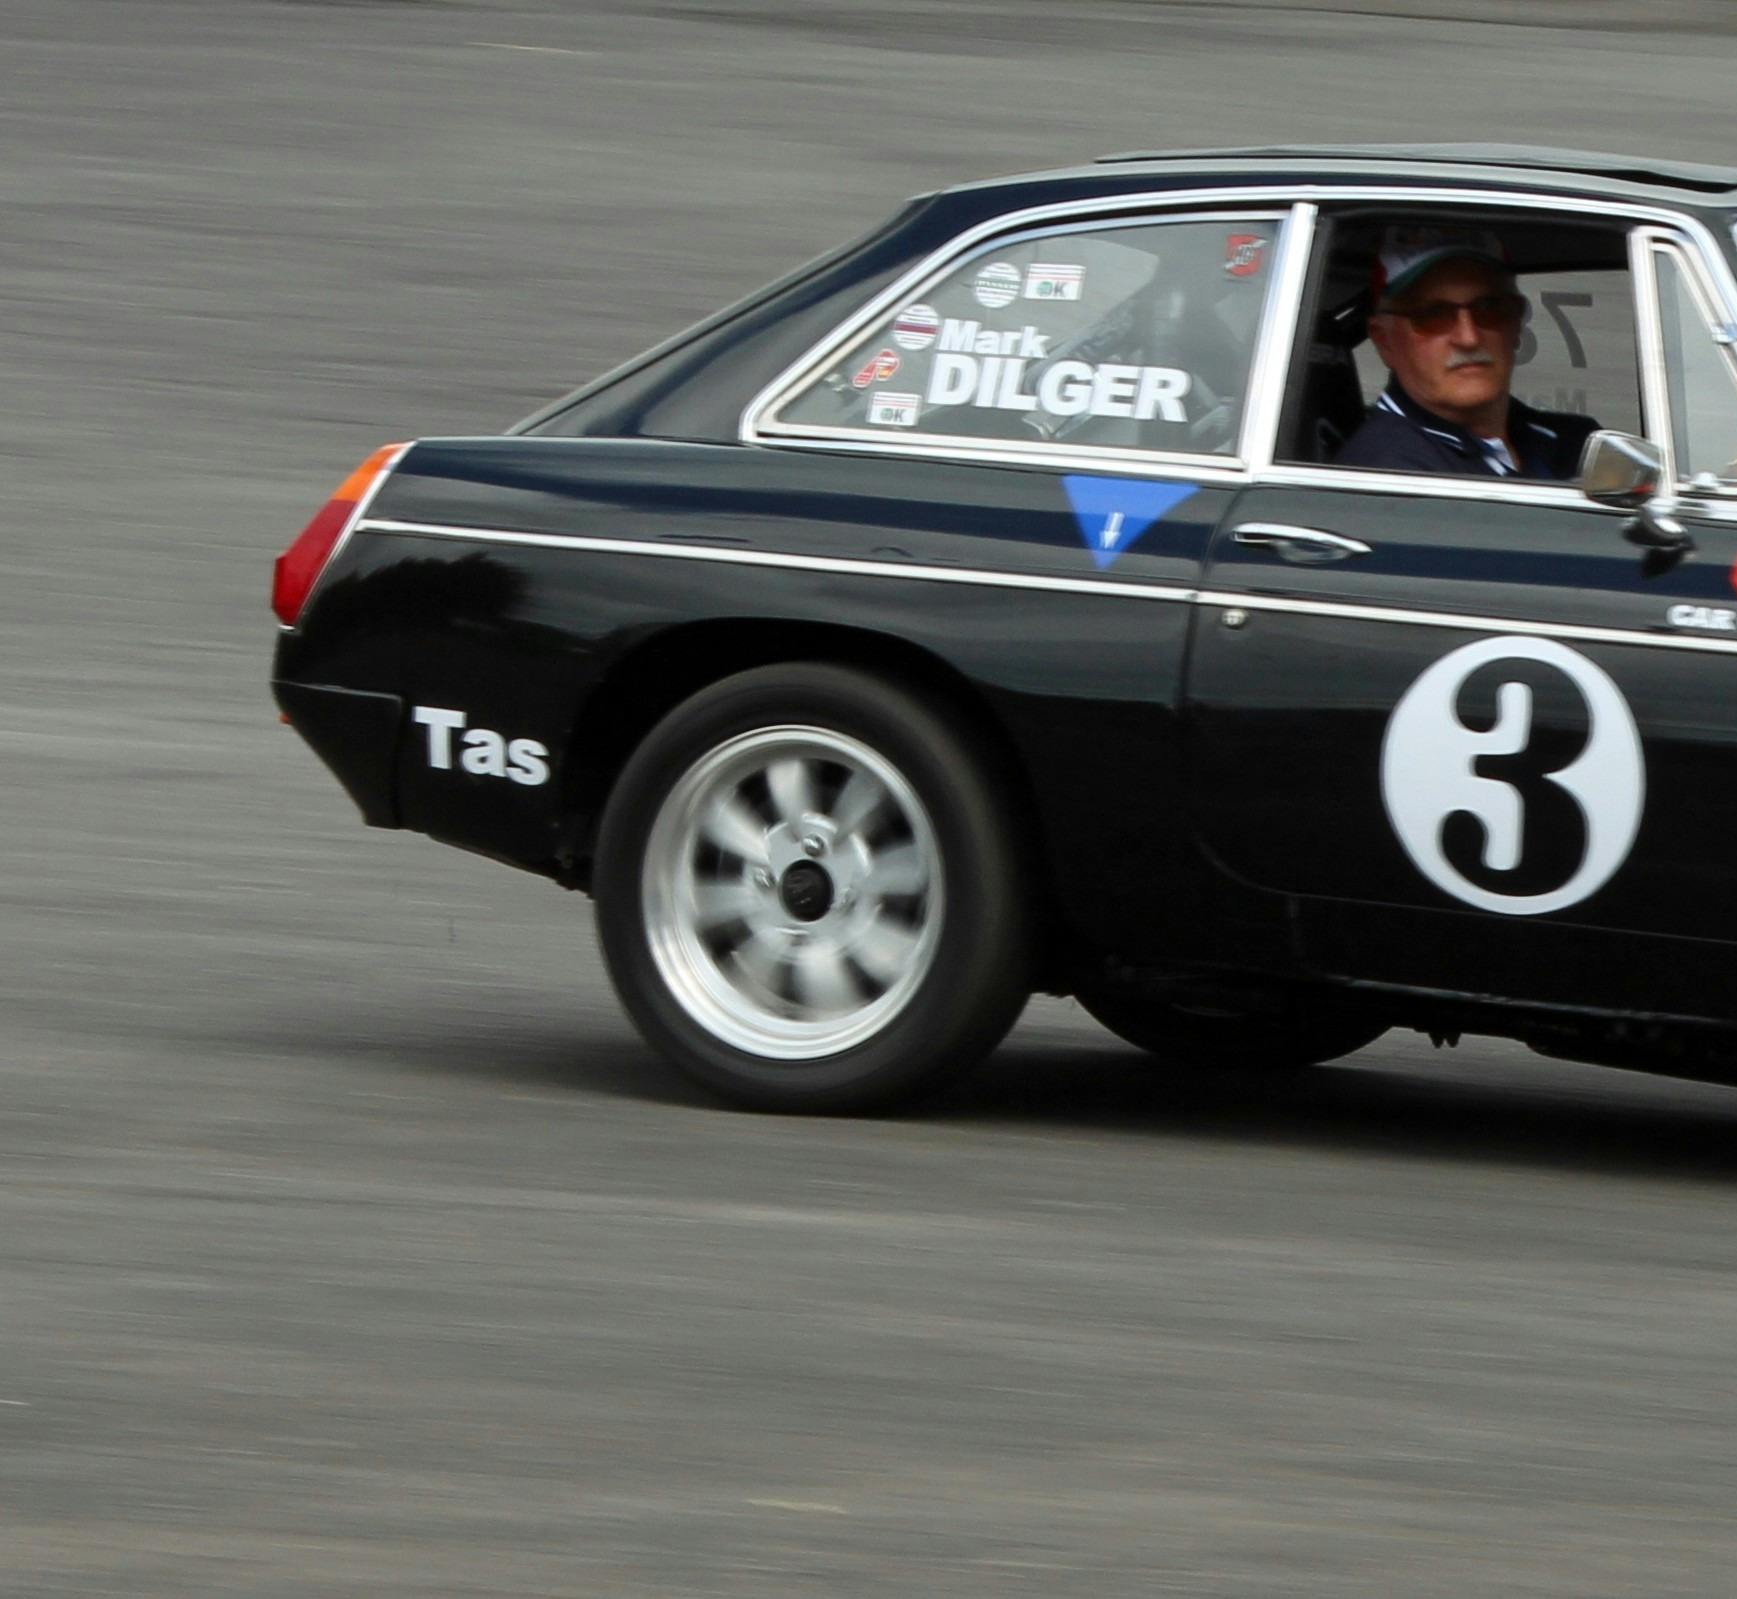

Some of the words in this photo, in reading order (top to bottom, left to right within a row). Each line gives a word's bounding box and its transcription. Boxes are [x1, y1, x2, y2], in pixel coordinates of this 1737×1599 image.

[938, 318, 1051, 358] Mark
[927, 353, 1192, 423] DILGER
[1668, 604, 1737, 631] CAR
[412, 705, 551, 786] Tas
[1437, 656, 1595, 897] 3
